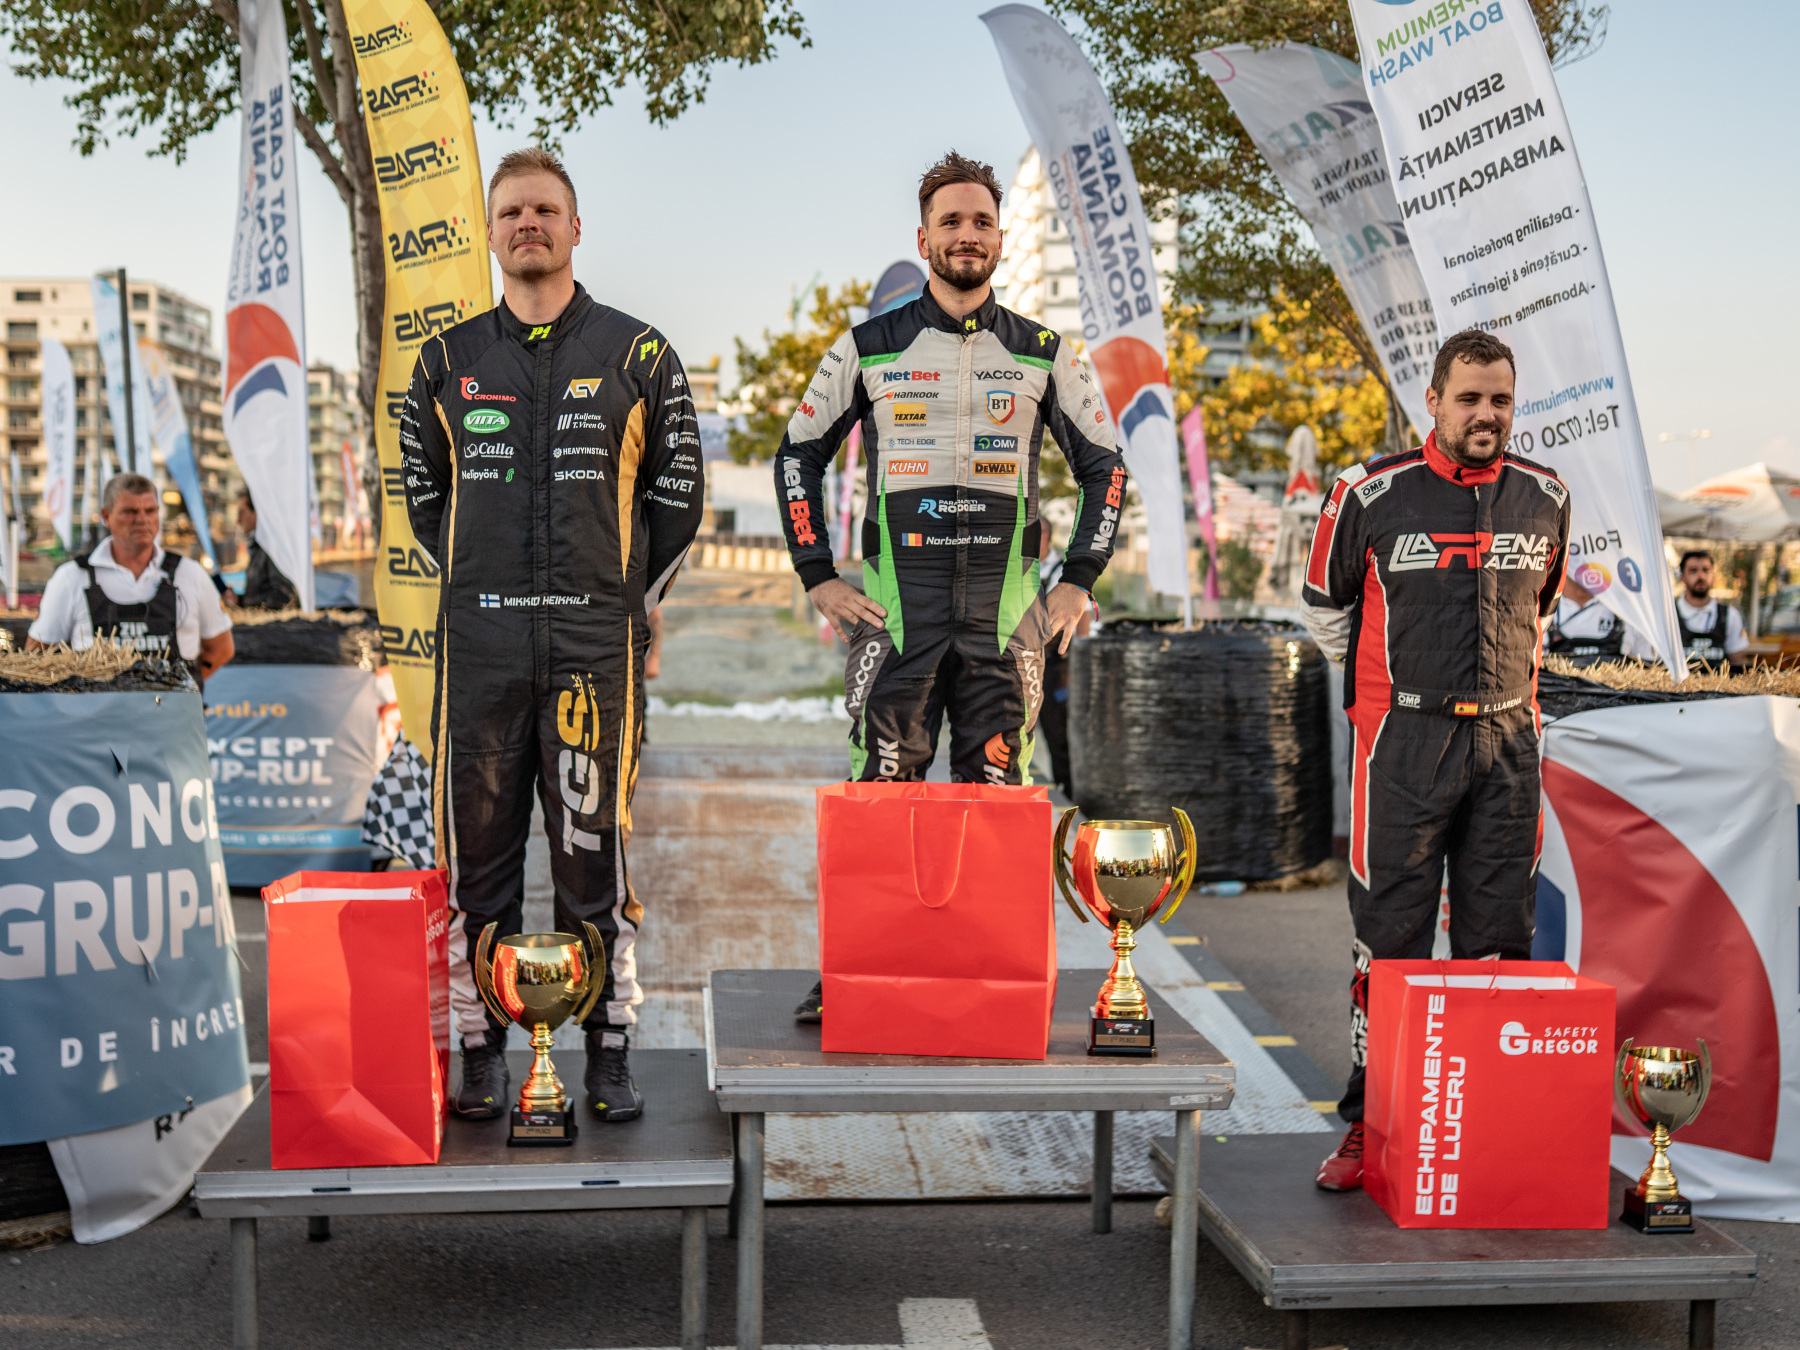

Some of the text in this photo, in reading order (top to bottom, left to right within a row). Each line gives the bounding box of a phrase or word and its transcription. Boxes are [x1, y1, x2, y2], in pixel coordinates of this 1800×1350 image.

[883, 371, 941, 382] NetBet
[974, 370, 1024, 380] YACCO
[474, 394, 517, 402] CRONIMO
[992, 399, 1009, 410] BT
[466, 415, 506, 426] VIITA
[573, 413, 601, 421] Kuljetus
[894, 413, 926, 421] TEXTAR
[897, 438, 936, 446] TECH EDGE
[993, 439, 1015, 448] OMV
[478, 442, 514, 456] Calla
[890, 462, 927, 473] KUHN
[462, 468, 499, 481] Nelipyörä
[1362, 480, 1385, 496] OMP
[1545, 480, 1564, 497] OMP
[784, 456, 817, 547] NetBet
[1090, 466, 1126, 552] NetBet
[973, 535, 1001, 544] Maior
[542, 594, 590, 606] HEIKKILÄ
[120, 621, 149, 637] ZIP
[849, 640, 881, 709] YACCO
[1398, 695, 1420, 706] OMP
[1493, 697, 1522, 712] LLARENA
[203, 701, 288, 718] -rul.ro
[207, 737, 335, 757] NCEPT
[60, 1031, 118, 1068] DE
[150, 998, 245, 1053] ÎNCRE
[1544, 1026, 1598, 1038] SAFETY
[1415, 994, 1446, 1216] ECHIPAMENTE
[1439, 1056, 1467, 1216] DE LUCRU
